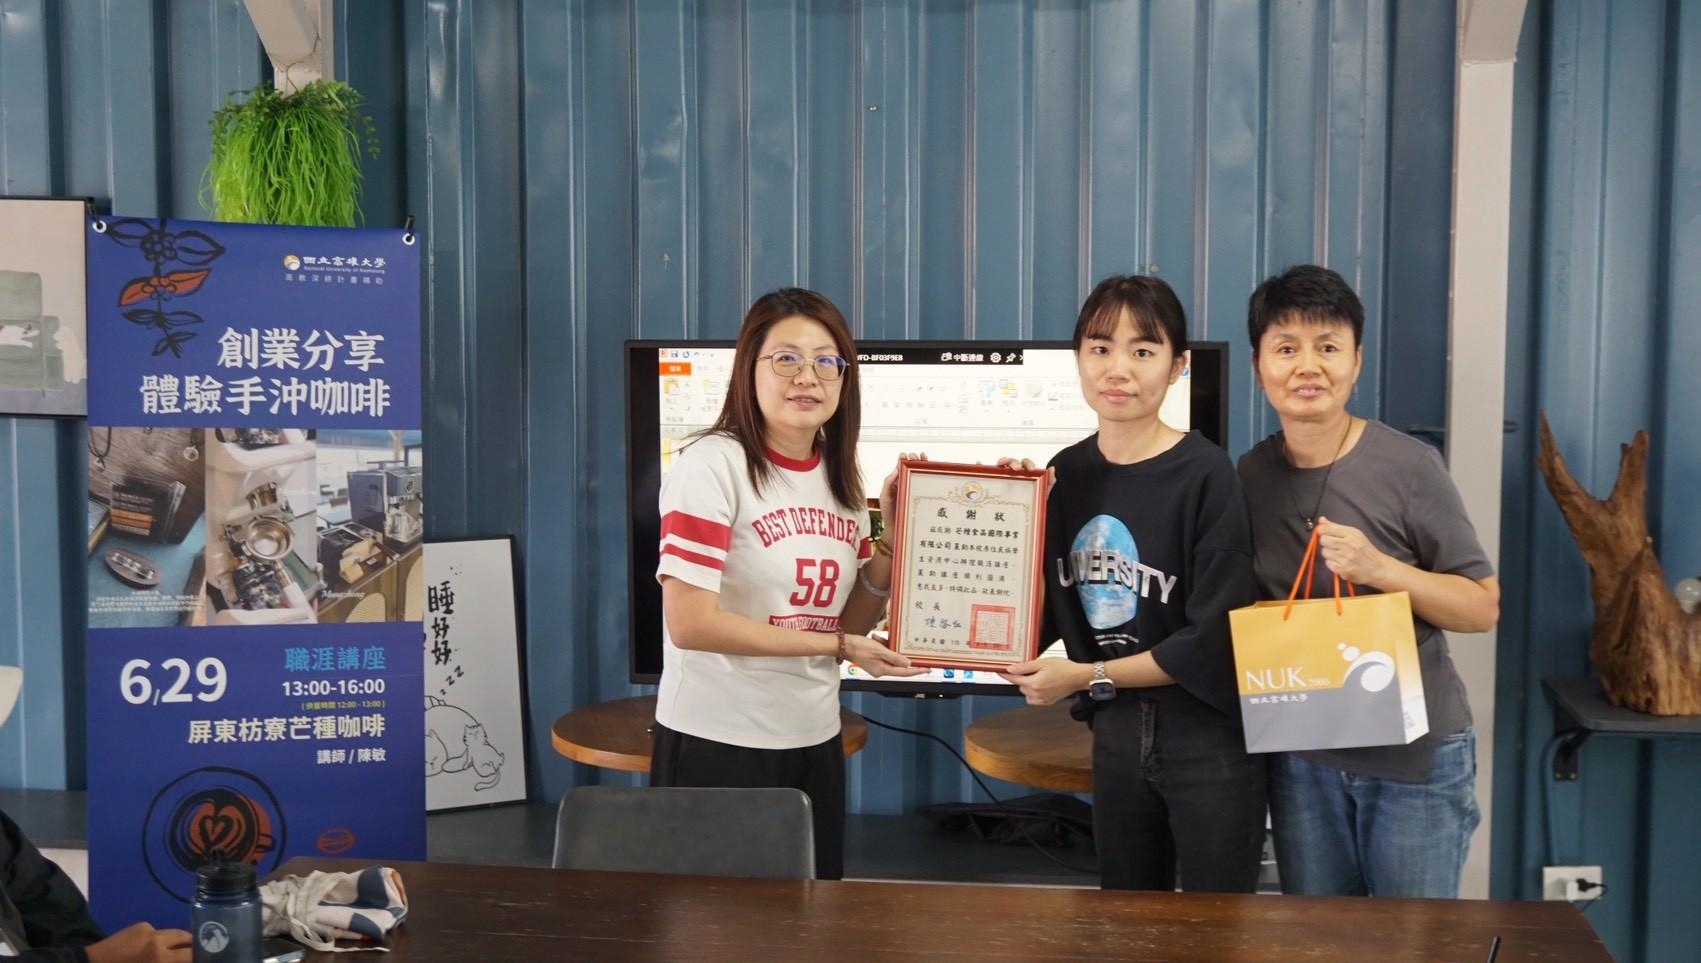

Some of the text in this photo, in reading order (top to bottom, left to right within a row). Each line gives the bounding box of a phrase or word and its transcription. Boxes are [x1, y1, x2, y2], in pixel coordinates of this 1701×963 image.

[216, 326, 385, 372] 創業分享
[857, 353, 903, 362] FD-BF03F9E8
[139, 373, 392, 417] 體驗手沖咖啡
[751, 508, 793, 549] BEST
[936, 507, 1006, 522] 感謝狀
[788, 558, 840, 608] 58
[1057, 549, 1178, 604] UVERSITY
[428, 580, 455, 666] 睡好好
[284, 645, 387, 672] 職涯講座
[120, 657, 228, 707] 6/29
[282, 678, 386, 697] 13:00-16:00
[1245, 666, 1308, 691] NUK
[187, 713, 386, 744] 屏東枋寮芒種咖啡
[316, 749, 346, 765] 講師
[357, 747, 387, 763] 陳敏
